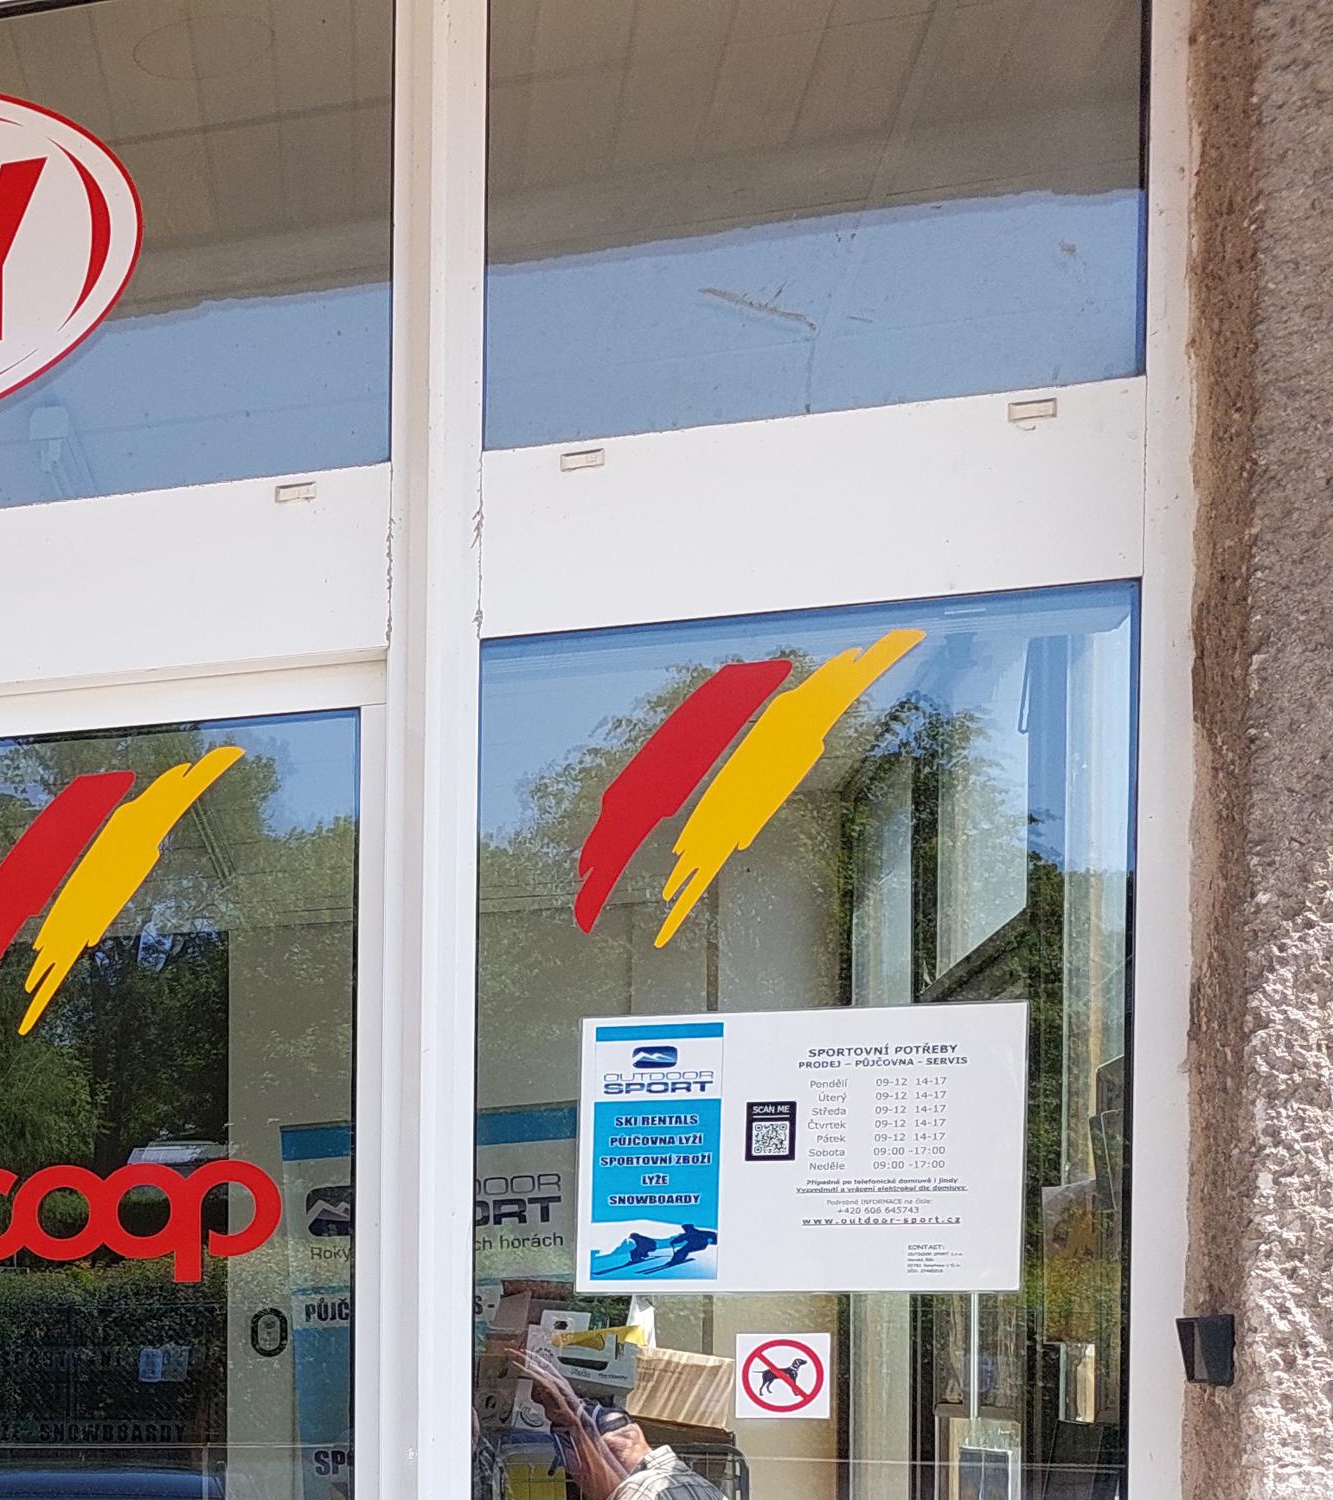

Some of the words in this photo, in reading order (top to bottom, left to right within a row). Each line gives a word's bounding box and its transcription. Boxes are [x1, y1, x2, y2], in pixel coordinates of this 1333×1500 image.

[808, 1044, 889, 1058] SPORTOVNÍ
[895, 1042, 958, 1056] POTŘEBY
[798, 1060, 841, 1069] PRODEJ
[926, 1056, 968, 1066] SERVIS
[603, 1071, 714, 1082] OUTDOOR
[603, 1080, 713, 1095] SPORT
[752, 1105, 775, 1114] SCAN
[776, 1105, 790, 1113] ME
[615, 1116, 637, 1127] SKI
[642, 1115, 698, 1126] RENTALS
[808, 1148, 845, 1158] Sobota
[600, 1153, 672, 1167] SPORTOVNÍ
[642, 1173, 668, 1185] LYŽE
[609, 1194, 701, 1206] SNOWBOARDY
[499, 1232, 564, 1250] horách
[310, 1245, 351, 1263] Roky
[305, 1297, 350, 1322] PŮJČ
